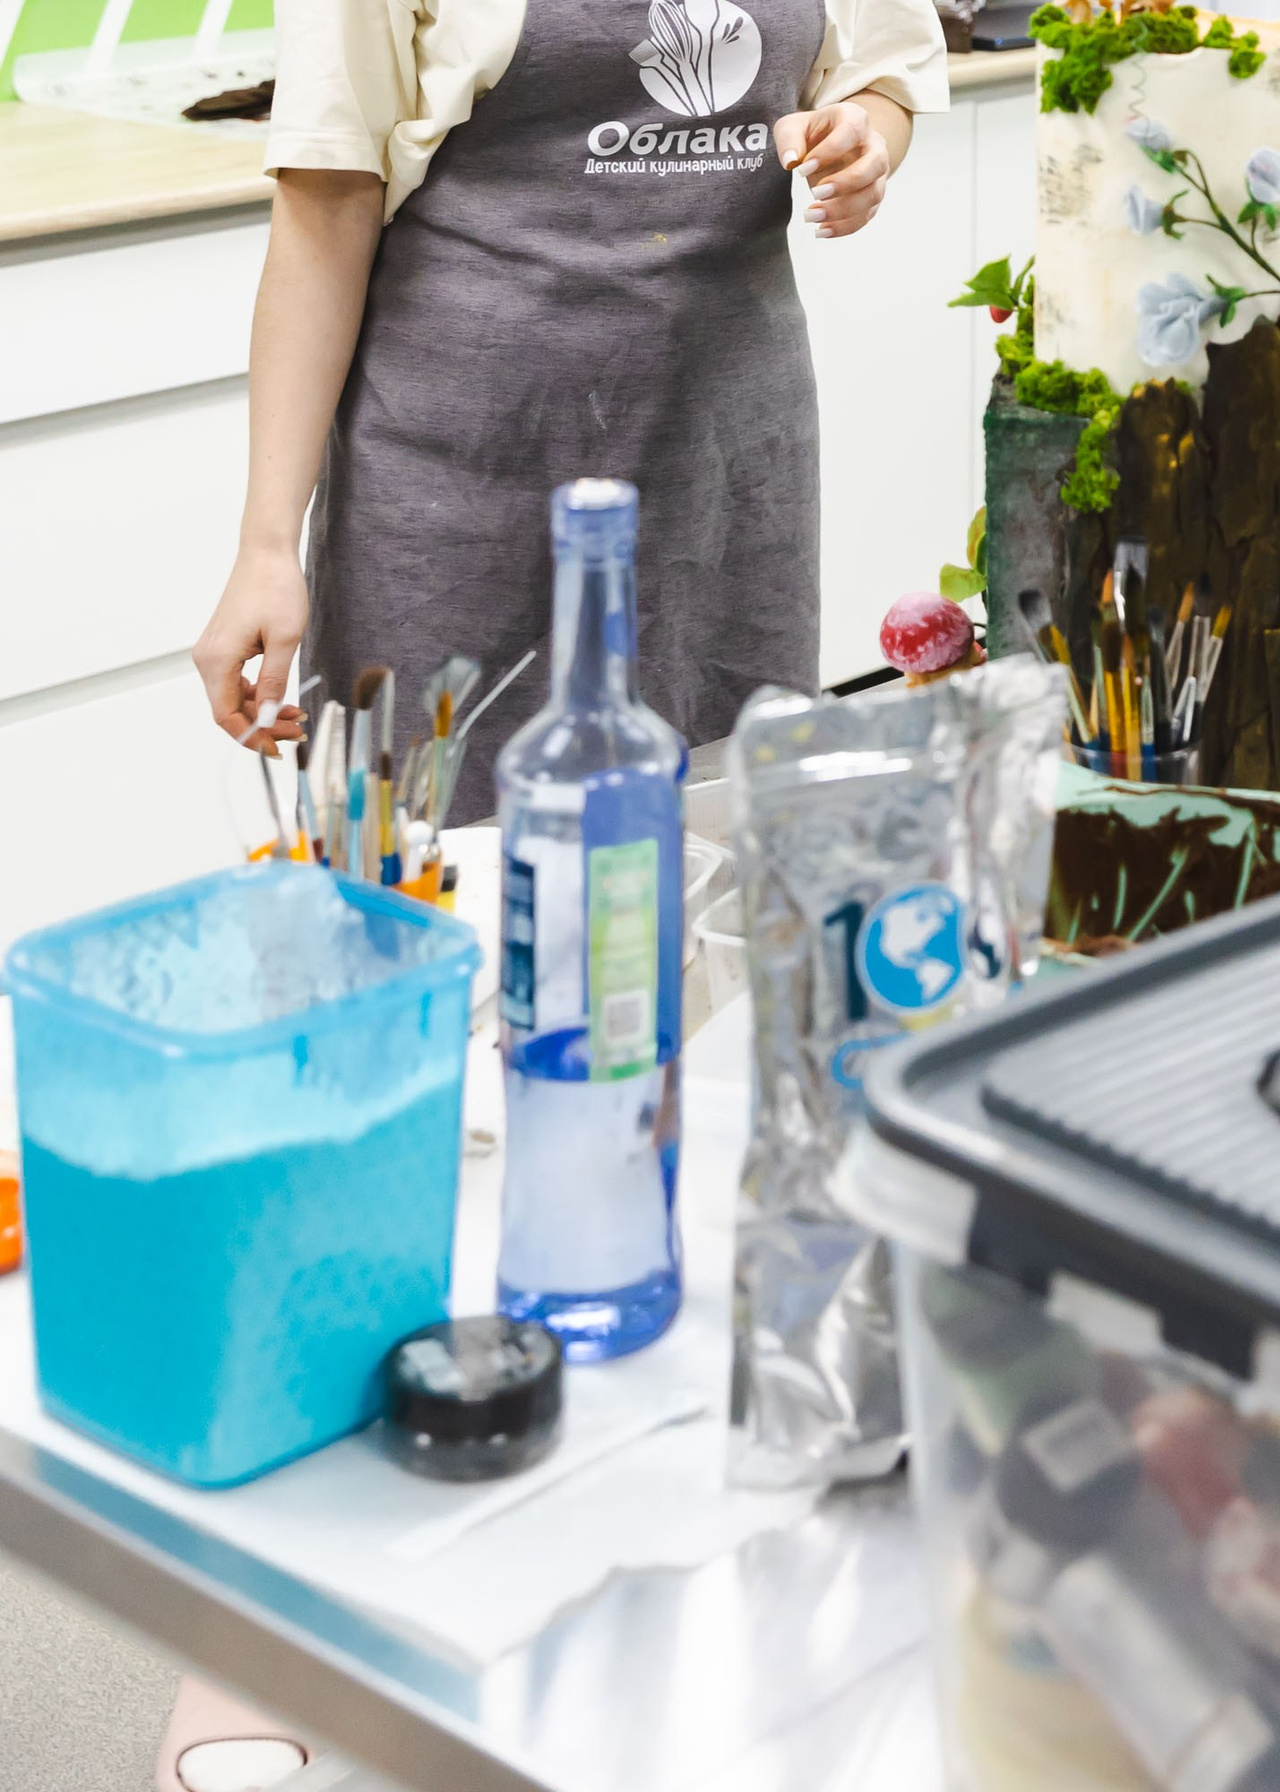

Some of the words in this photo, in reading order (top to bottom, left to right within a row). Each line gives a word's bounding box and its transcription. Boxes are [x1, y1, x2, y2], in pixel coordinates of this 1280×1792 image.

[587, 120, 769, 157] Облака
[584, 158, 646, 174] Детский
[650, 155, 734, 176] кулинарный
[737, 153, 764, 172] клуб
